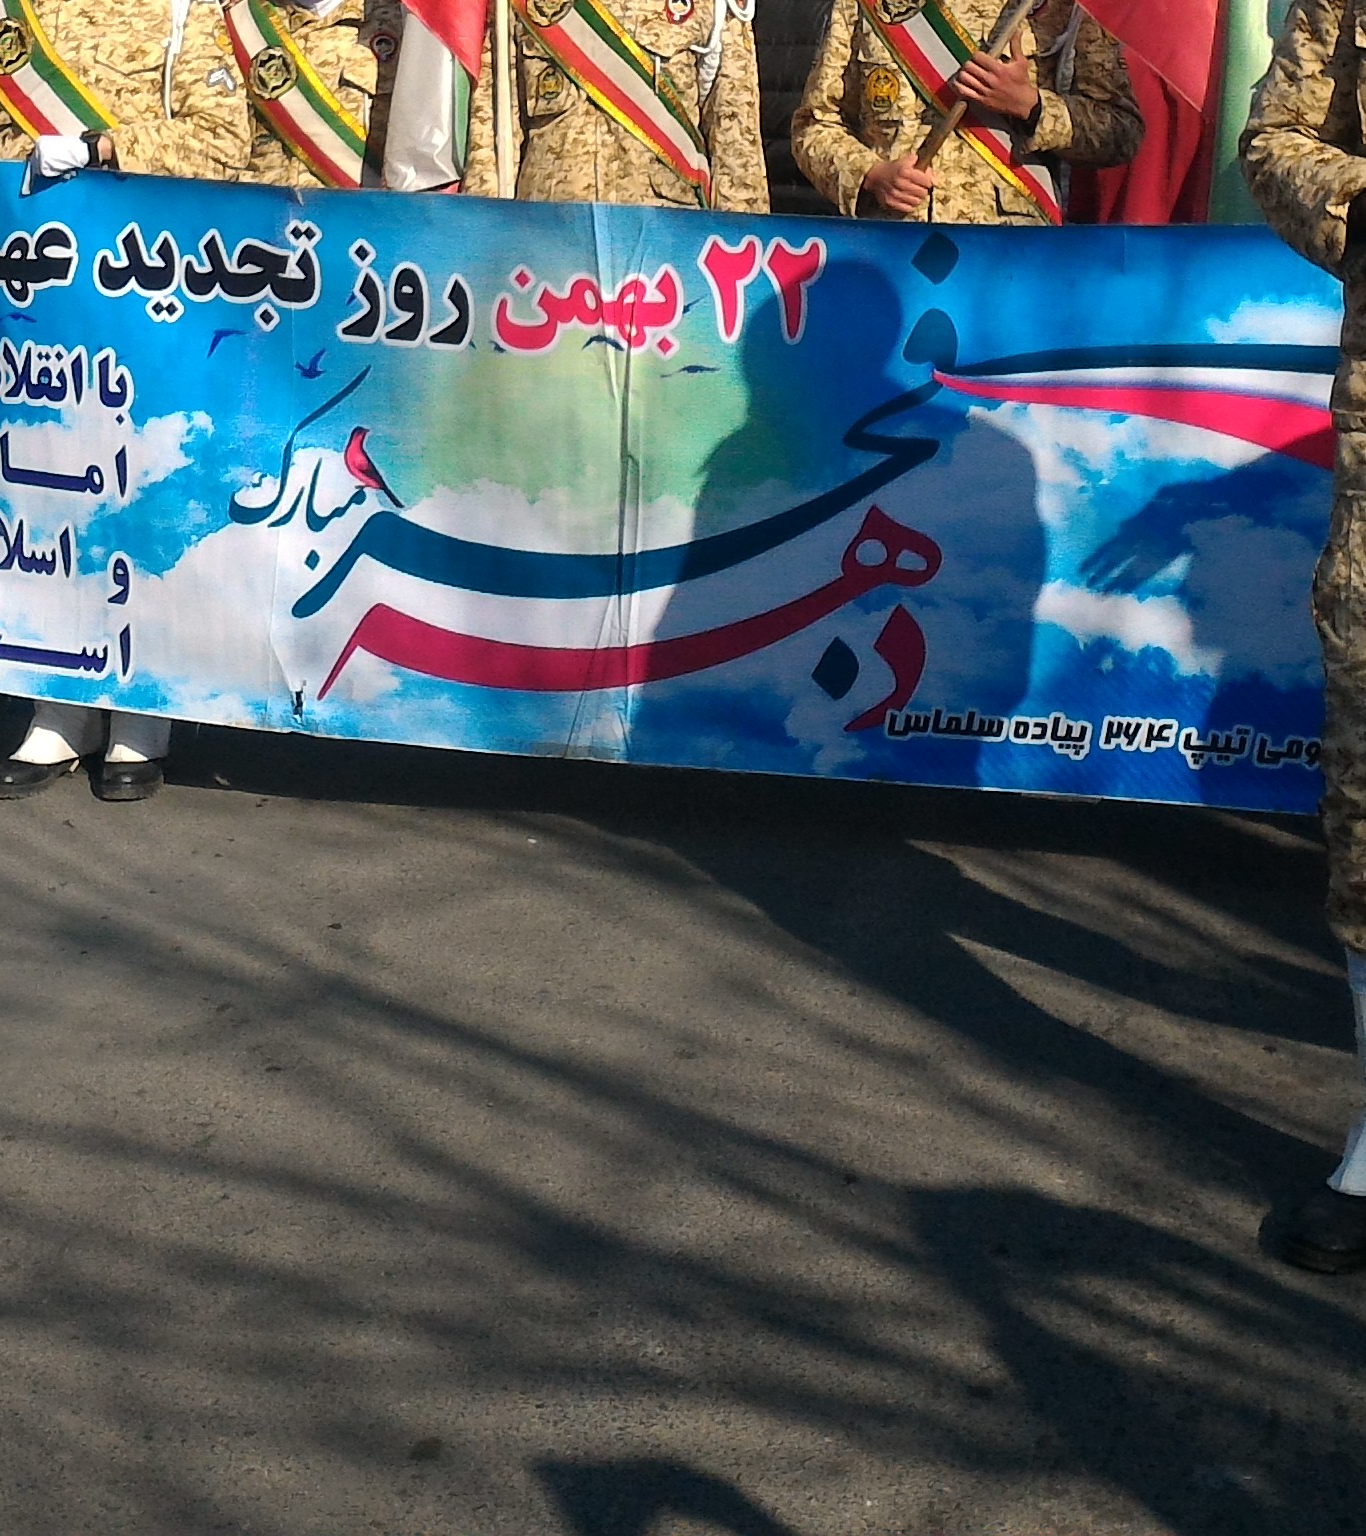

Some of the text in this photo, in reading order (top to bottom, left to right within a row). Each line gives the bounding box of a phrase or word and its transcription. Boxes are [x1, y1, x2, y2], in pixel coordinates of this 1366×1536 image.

[96, 221, 319, 328] تجدید
[339, 242, 470, 344] روز
[702, 237, 824, 342] ۲۲
[495, 267, 681, 359] بهمن
[97, 351, 130, 426] با
[106, 556, 131, 606] و
[887, 710, 1006, 743] سلماس
[1013, 716, 1089, 758] پیاده
[1182, 727, 1252, 766] تیپ
